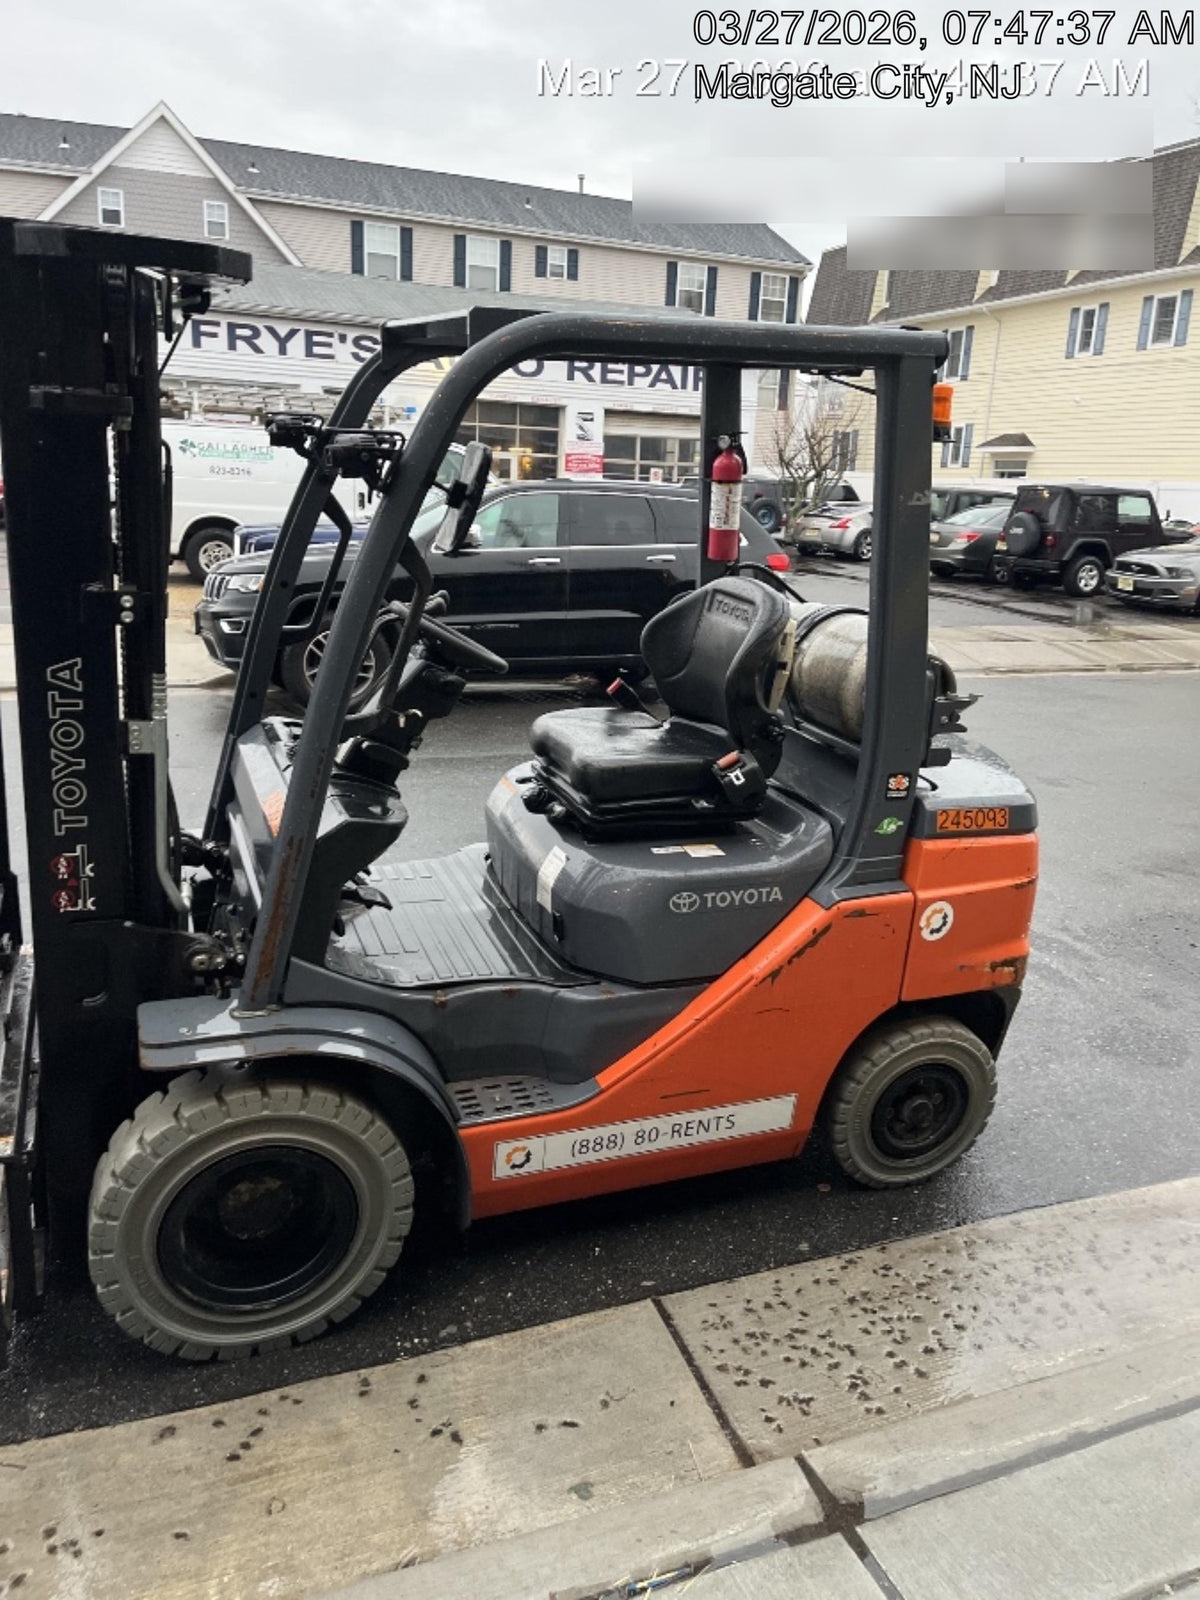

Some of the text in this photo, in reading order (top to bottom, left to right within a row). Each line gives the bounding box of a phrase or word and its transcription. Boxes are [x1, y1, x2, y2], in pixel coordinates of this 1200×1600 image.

[191, 318, 382, 363] FRYE'S
[47, 657, 88, 836] TOYOTA
[938, 808, 1008, 831] 245093
[703, 887, 783, 908] TOYOTA
[571, 1114, 736, 1158] (888) 80-RENTS
